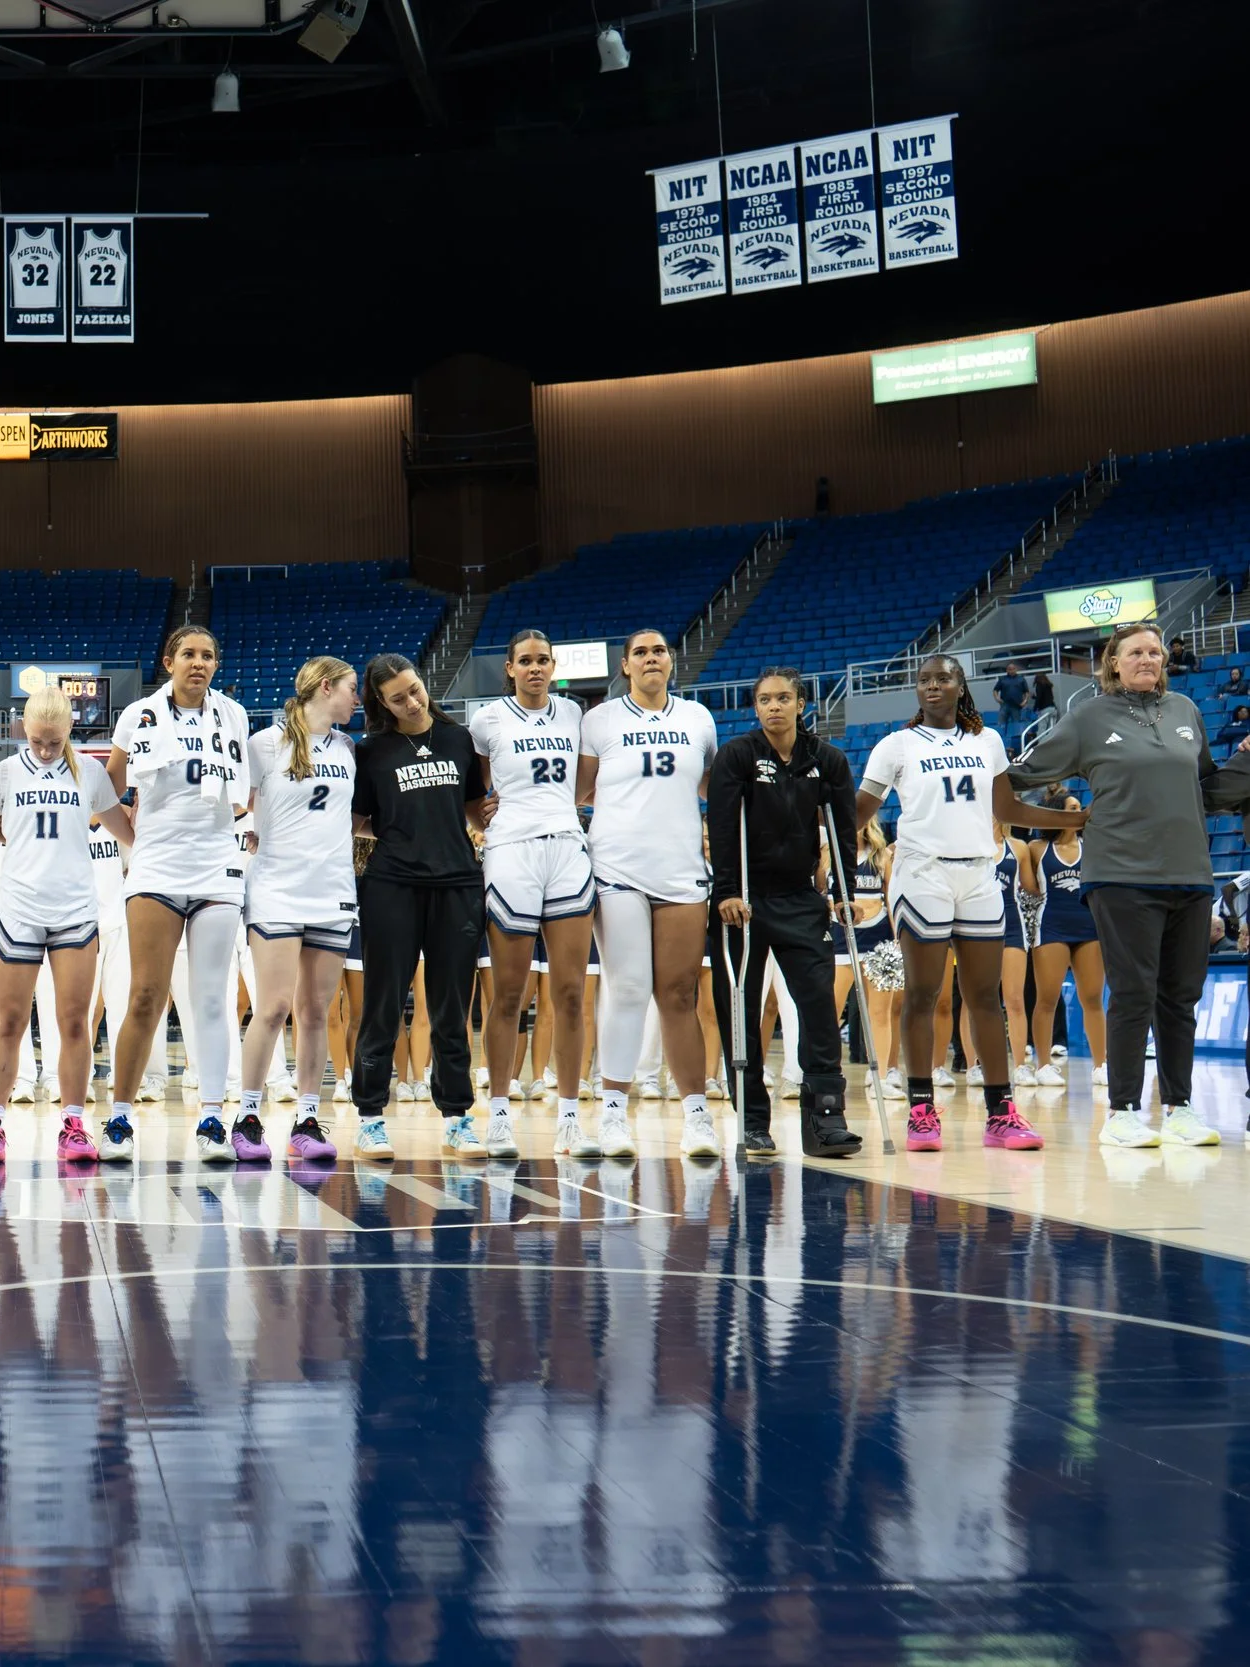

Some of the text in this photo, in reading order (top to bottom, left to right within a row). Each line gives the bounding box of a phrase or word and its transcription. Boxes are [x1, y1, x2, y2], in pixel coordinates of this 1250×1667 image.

[893, 134, 935, 162] NIT
[806, 146, 868, 177] NCAA
[730, 161, 791, 191] NCAA
[902, 165, 933, 180] 1997
[669, 176, 708, 201] NIT
[823, 180, 854, 193] 1985
[885, 174, 950, 194] SECOND
[747, 194, 777, 207] 1984
[819, 191, 859, 206] FIRST
[893, 187, 942, 204] ROUND
[675, 206, 704, 218] 1979
[743, 204, 782, 219] FIRST
[815, 202, 864, 218] ROUND
[888, 205, 950, 229] NEVADA
[660, 214, 720, 233] SECOND
[739, 215, 787, 231] ROUND
[811, 219, 872, 242] NEVADA
[668, 227, 712, 243] ROUND
[735, 232, 794, 255] NEVADA
[17, 246, 53, 260] NEVADA
[85, 247, 121, 260] NEVADA
[663, 244, 720, 266] NEVADA
[888, 244, 954, 261] BASKETBALL
[811, 257, 875, 274] BASKETBALL
[22, 264, 48, 286] 32
[90, 264, 115, 286] 22
[735, 270, 797, 286] BASKETBALL
[664, 279, 723, 296] BASKETBALL
[17, 314, 54, 324] JONES
[75, 315, 130, 324] FAZEKAS
[1079, 595, 1122, 617] Starry
[514, 738, 573, 754] NEVADA
[623, 731, 690, 747] NEVADA
[187, 759, 202, 784] 0
[395, 760, 460, 783] NEVADA
[531, 758, 566, 784] 23
[642, 751, 675, 777] 13
[920, 756, 985, 773] NEVADA
[399, 775, 459, 792] BASKETBALL
[942, 775, 976, 802] 14
[16, 790, 80, 807] NEVADA
[309, 785, 330, 810] 2
[36, 812, 58, 839] 11
